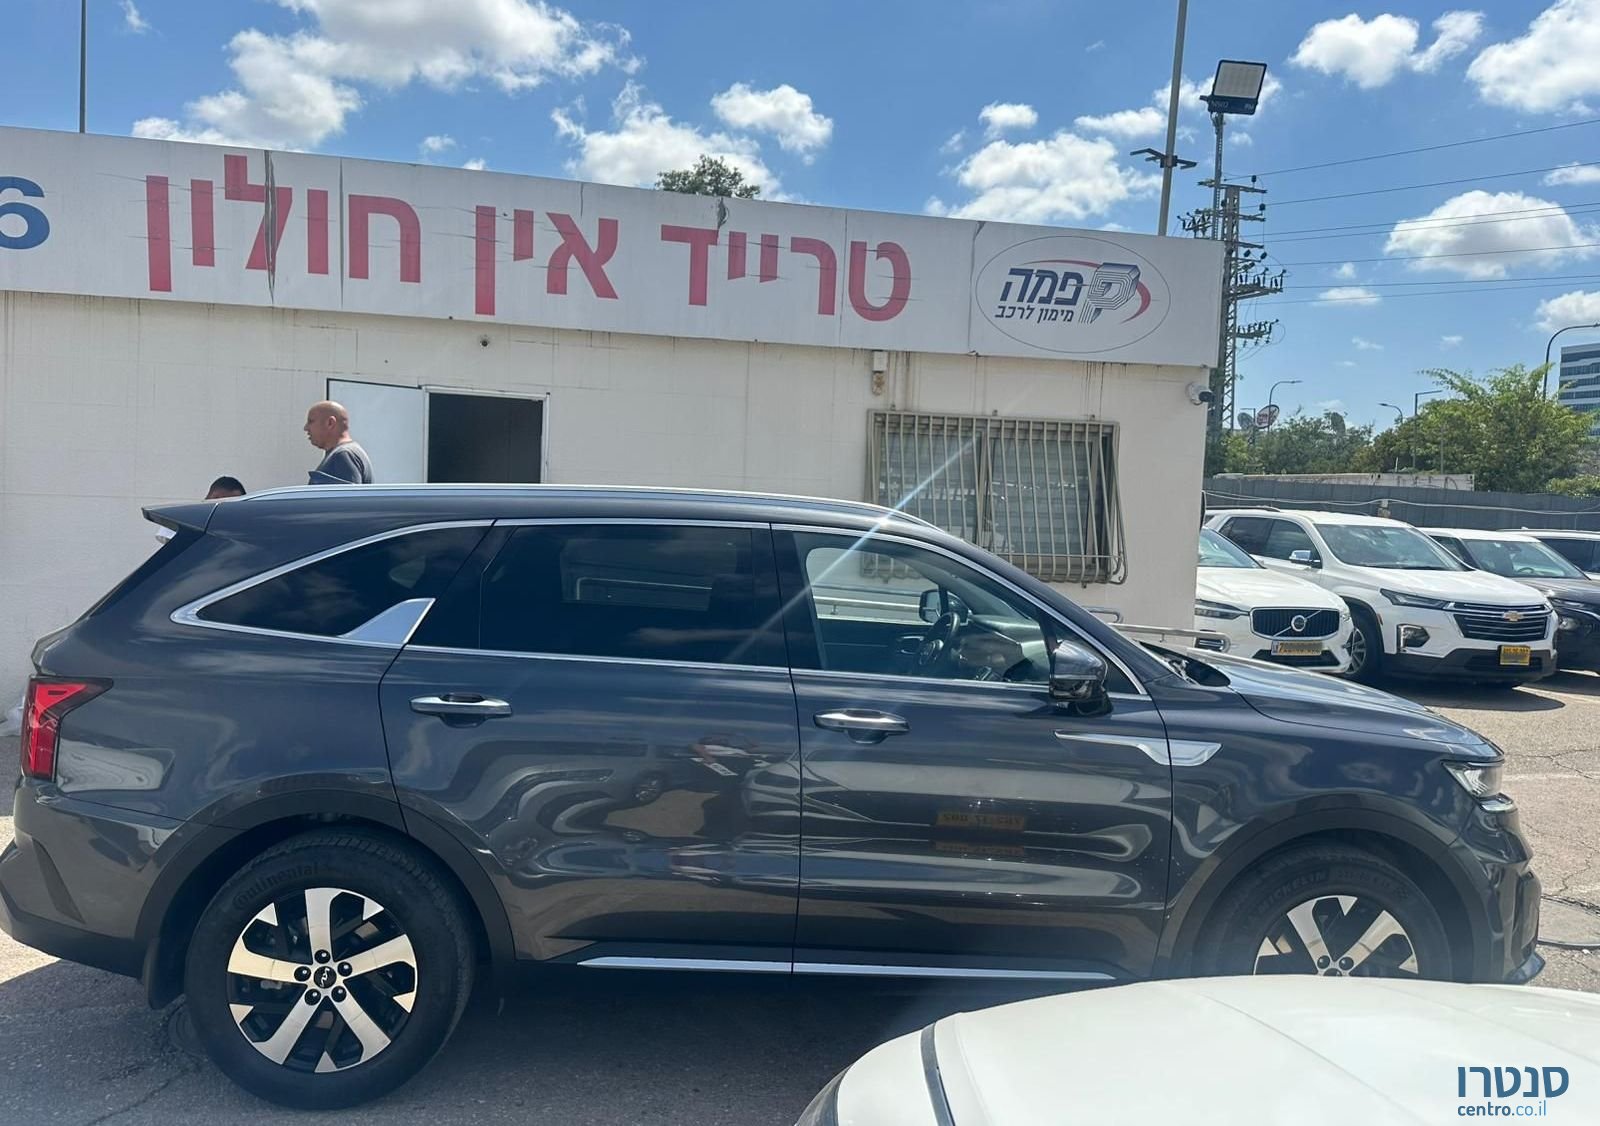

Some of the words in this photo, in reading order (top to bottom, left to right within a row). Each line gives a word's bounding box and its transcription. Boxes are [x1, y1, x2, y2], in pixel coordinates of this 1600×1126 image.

[0, 176, 51, 250] 6
[145, 153, 422, 293] חולון
[474, 205, 620, 316] אין
[660, 224, 912, 323] טרייד
[994, 304, 1035, 320] לרכב
[1036, 307, 1075, 324] מימון
